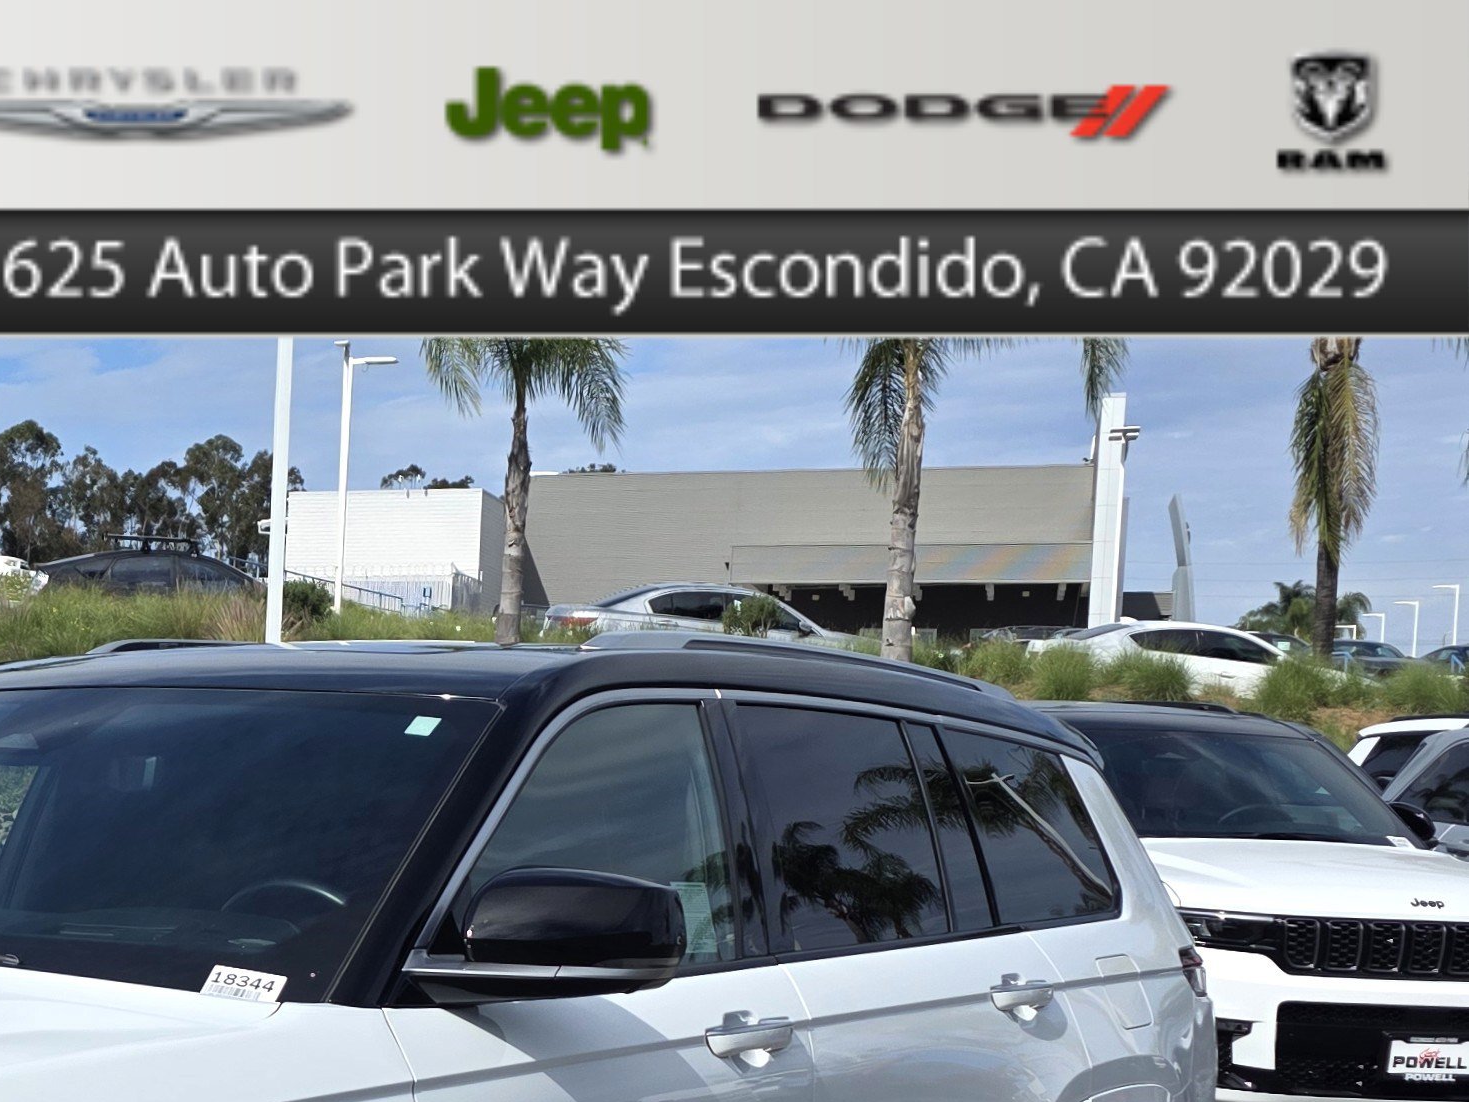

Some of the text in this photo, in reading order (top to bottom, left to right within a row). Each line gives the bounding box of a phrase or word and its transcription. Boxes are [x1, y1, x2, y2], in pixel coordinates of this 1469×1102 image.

[1410, 898, 1445, 910] Jeep
[211, 971, 276, 993] 18344
[1392, 1055, 1468, 1070] POWELL
